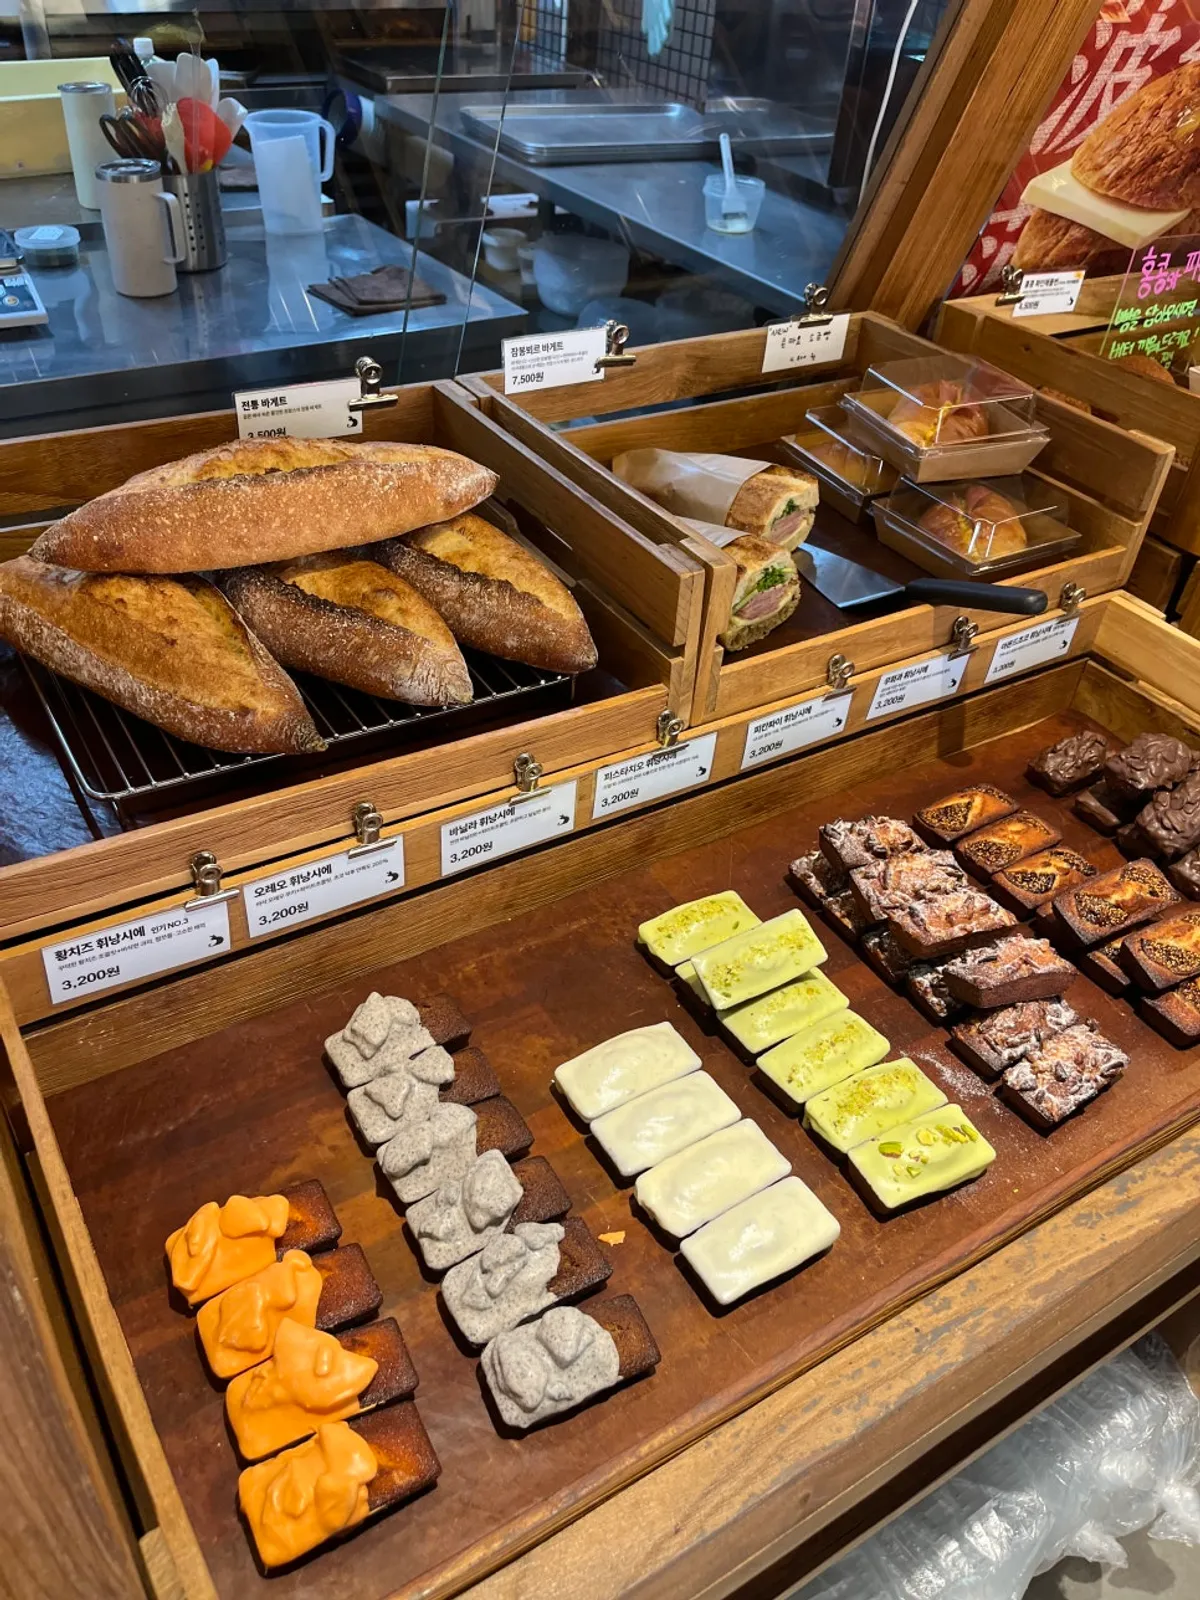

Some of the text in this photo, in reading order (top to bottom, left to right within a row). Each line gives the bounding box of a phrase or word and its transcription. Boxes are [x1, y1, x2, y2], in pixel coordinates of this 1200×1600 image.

[510, 345, 541, 358] 잠봉뵈르
[541, 341, 564, 353] 바게트
[1108, 340, 1136, 360] 버터
[512, 372, 544, 385] 7,500원
[241, 396, 287, 411] 전통 바게트
[904, 664, 929, 680] 휘낭시에
[875, 694, 905, 710] 3,200원
[754, 716, 783, 734] 피칸파이
[784, 705, 812, 721] 휘낭시에
[749, 739, 783, 759] 3,200원
[603, 761, 644, 781] 피스타치오
[601, 788, 639, 807] 3,200원
[449, 820, 478, 836] 바닐라
[479, 807, 516, 827] 휘낭시에
[450, 841, 493, 864] 3,200원
[253, 864, 333, 898] 오레오 휘낭시에
[259, 901, 309, 926] 3,200원
[54, 941, 94, 962] 황치즈
[96, 926, 146, 950] 휘낭시에
[61, 965, 120, 990] 3,200원
